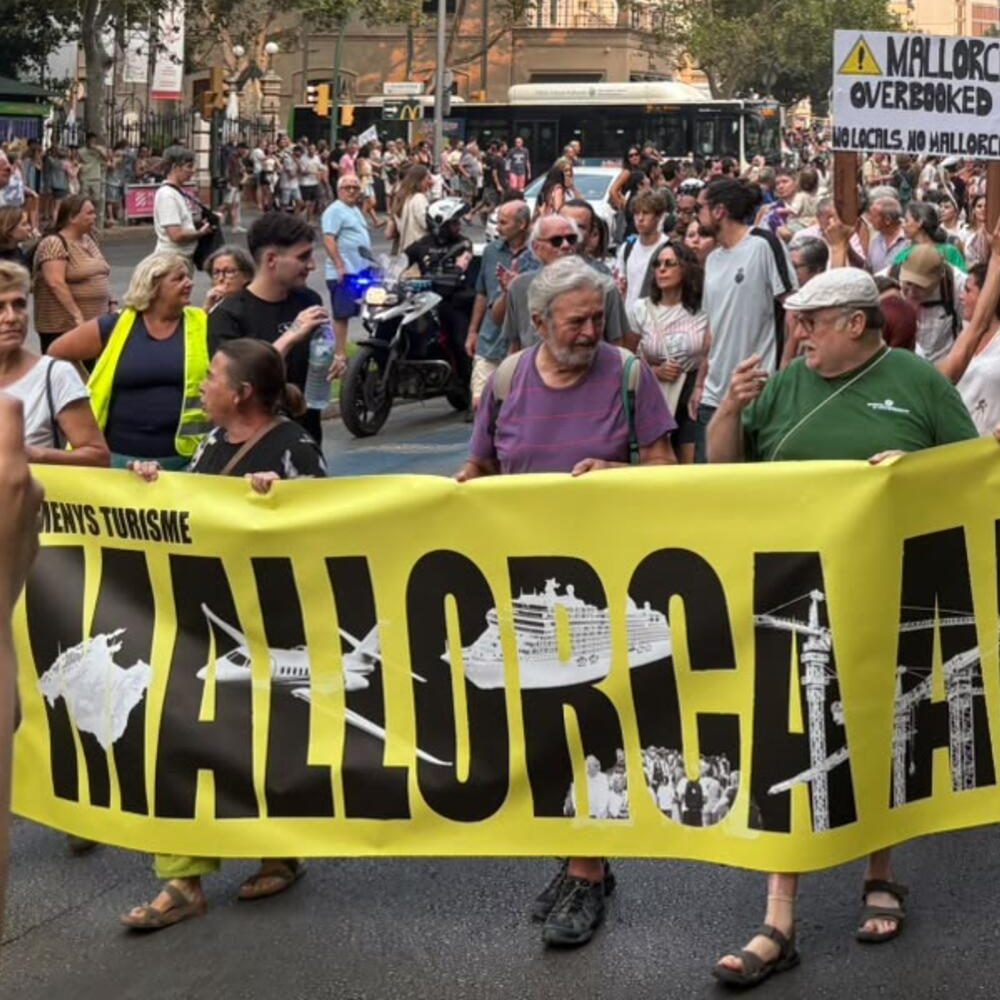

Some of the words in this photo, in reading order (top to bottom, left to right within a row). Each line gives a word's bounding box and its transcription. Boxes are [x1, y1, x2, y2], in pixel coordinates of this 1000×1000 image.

[850, 81, 993, 116] OVERBOOKED
[832, 126, 849, 148] NO
[907, 130, 926, 152] NO
[100, 506, 192, 544] TURISME
[25, 545, 857, 833] MALLORCA
